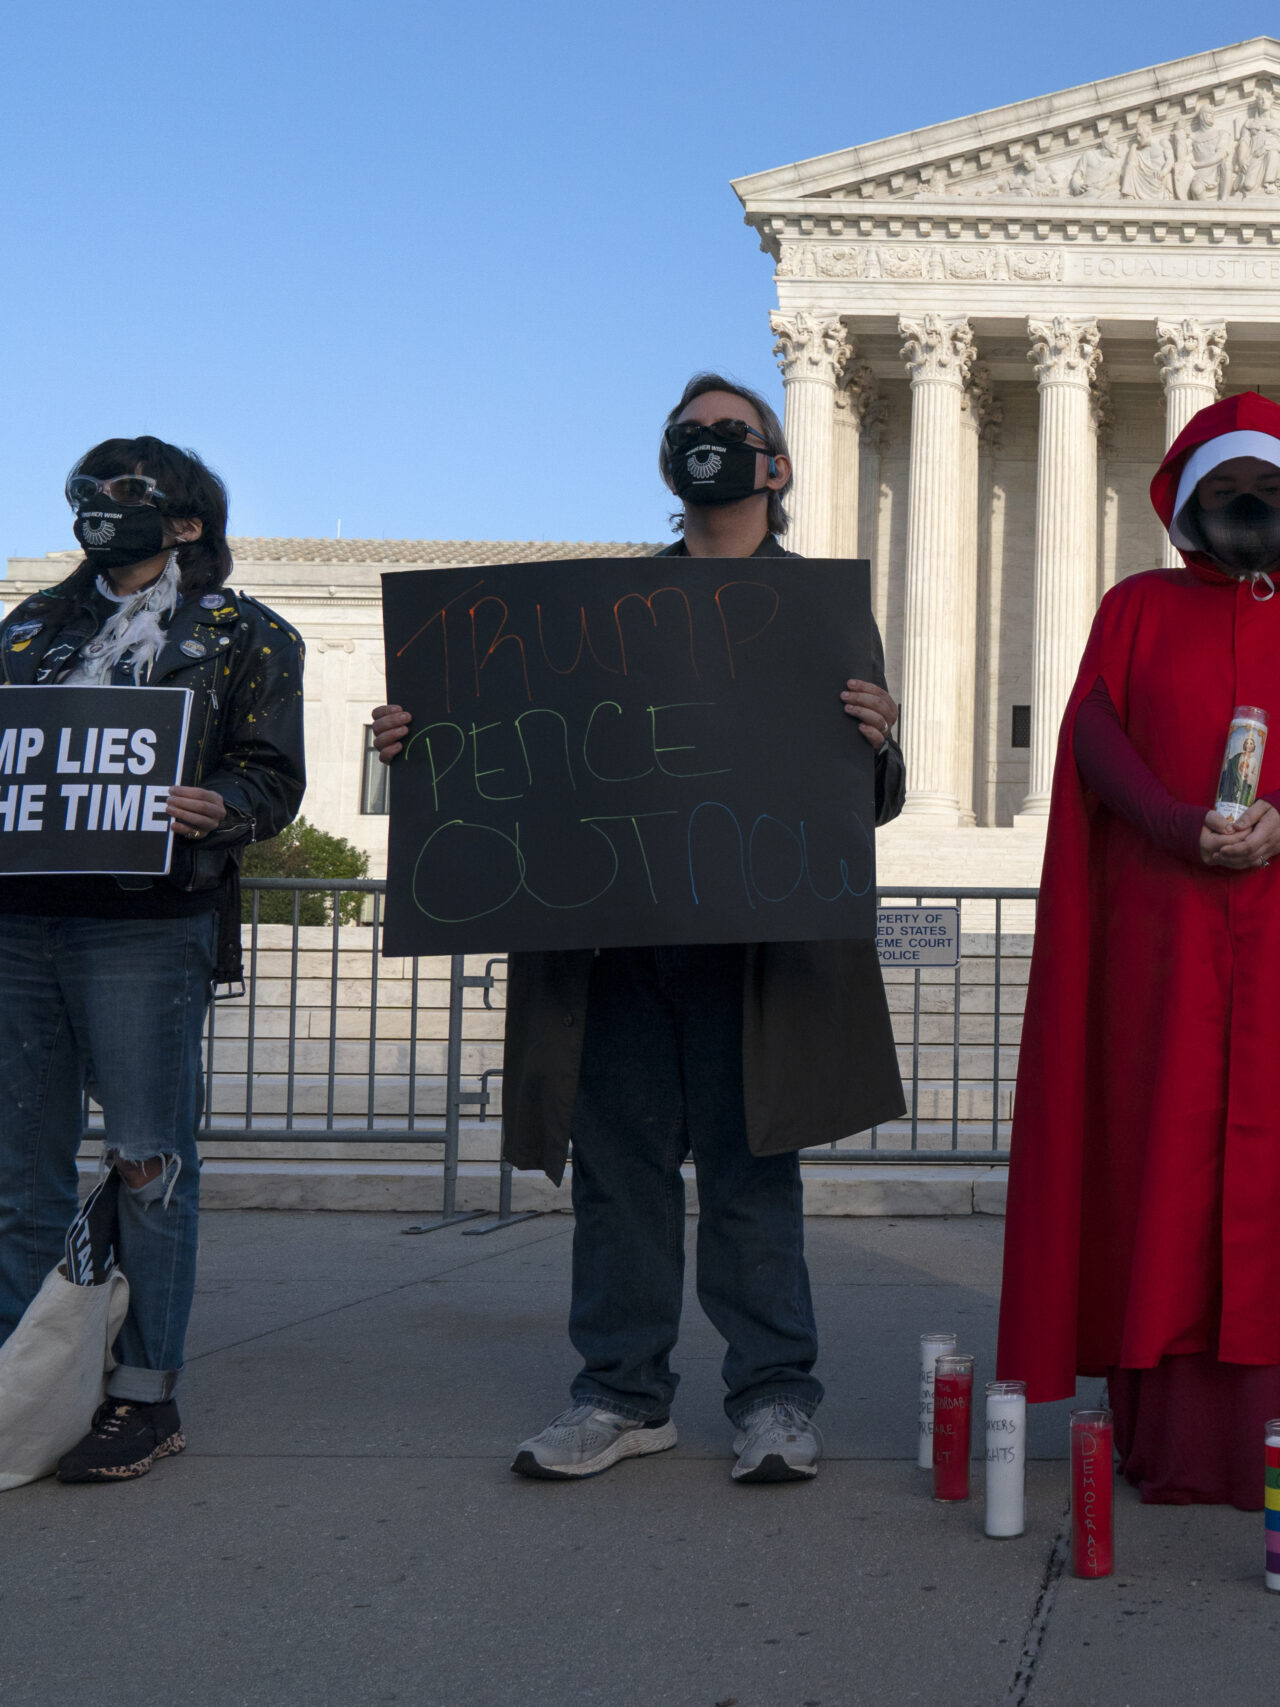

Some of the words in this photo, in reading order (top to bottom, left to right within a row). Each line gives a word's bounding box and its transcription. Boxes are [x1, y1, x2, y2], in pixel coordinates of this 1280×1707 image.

[1082, 256, 1171, 278] EQUAL
[1176, 257, 1280, 280] JUSTICE
[56, 727, 157, 775] LIES
[60, 784, 171, 832] TIME
[413, 811, 679, 922] OUT
[878, 914, 920, 924] PERTY
[925, 914, 943, 924] OF
[901, 926, 946, 936] STATES
[908, 938, 953, 948] COURT
[1080, 1431, 1097, 1576] DEMOCRACY
